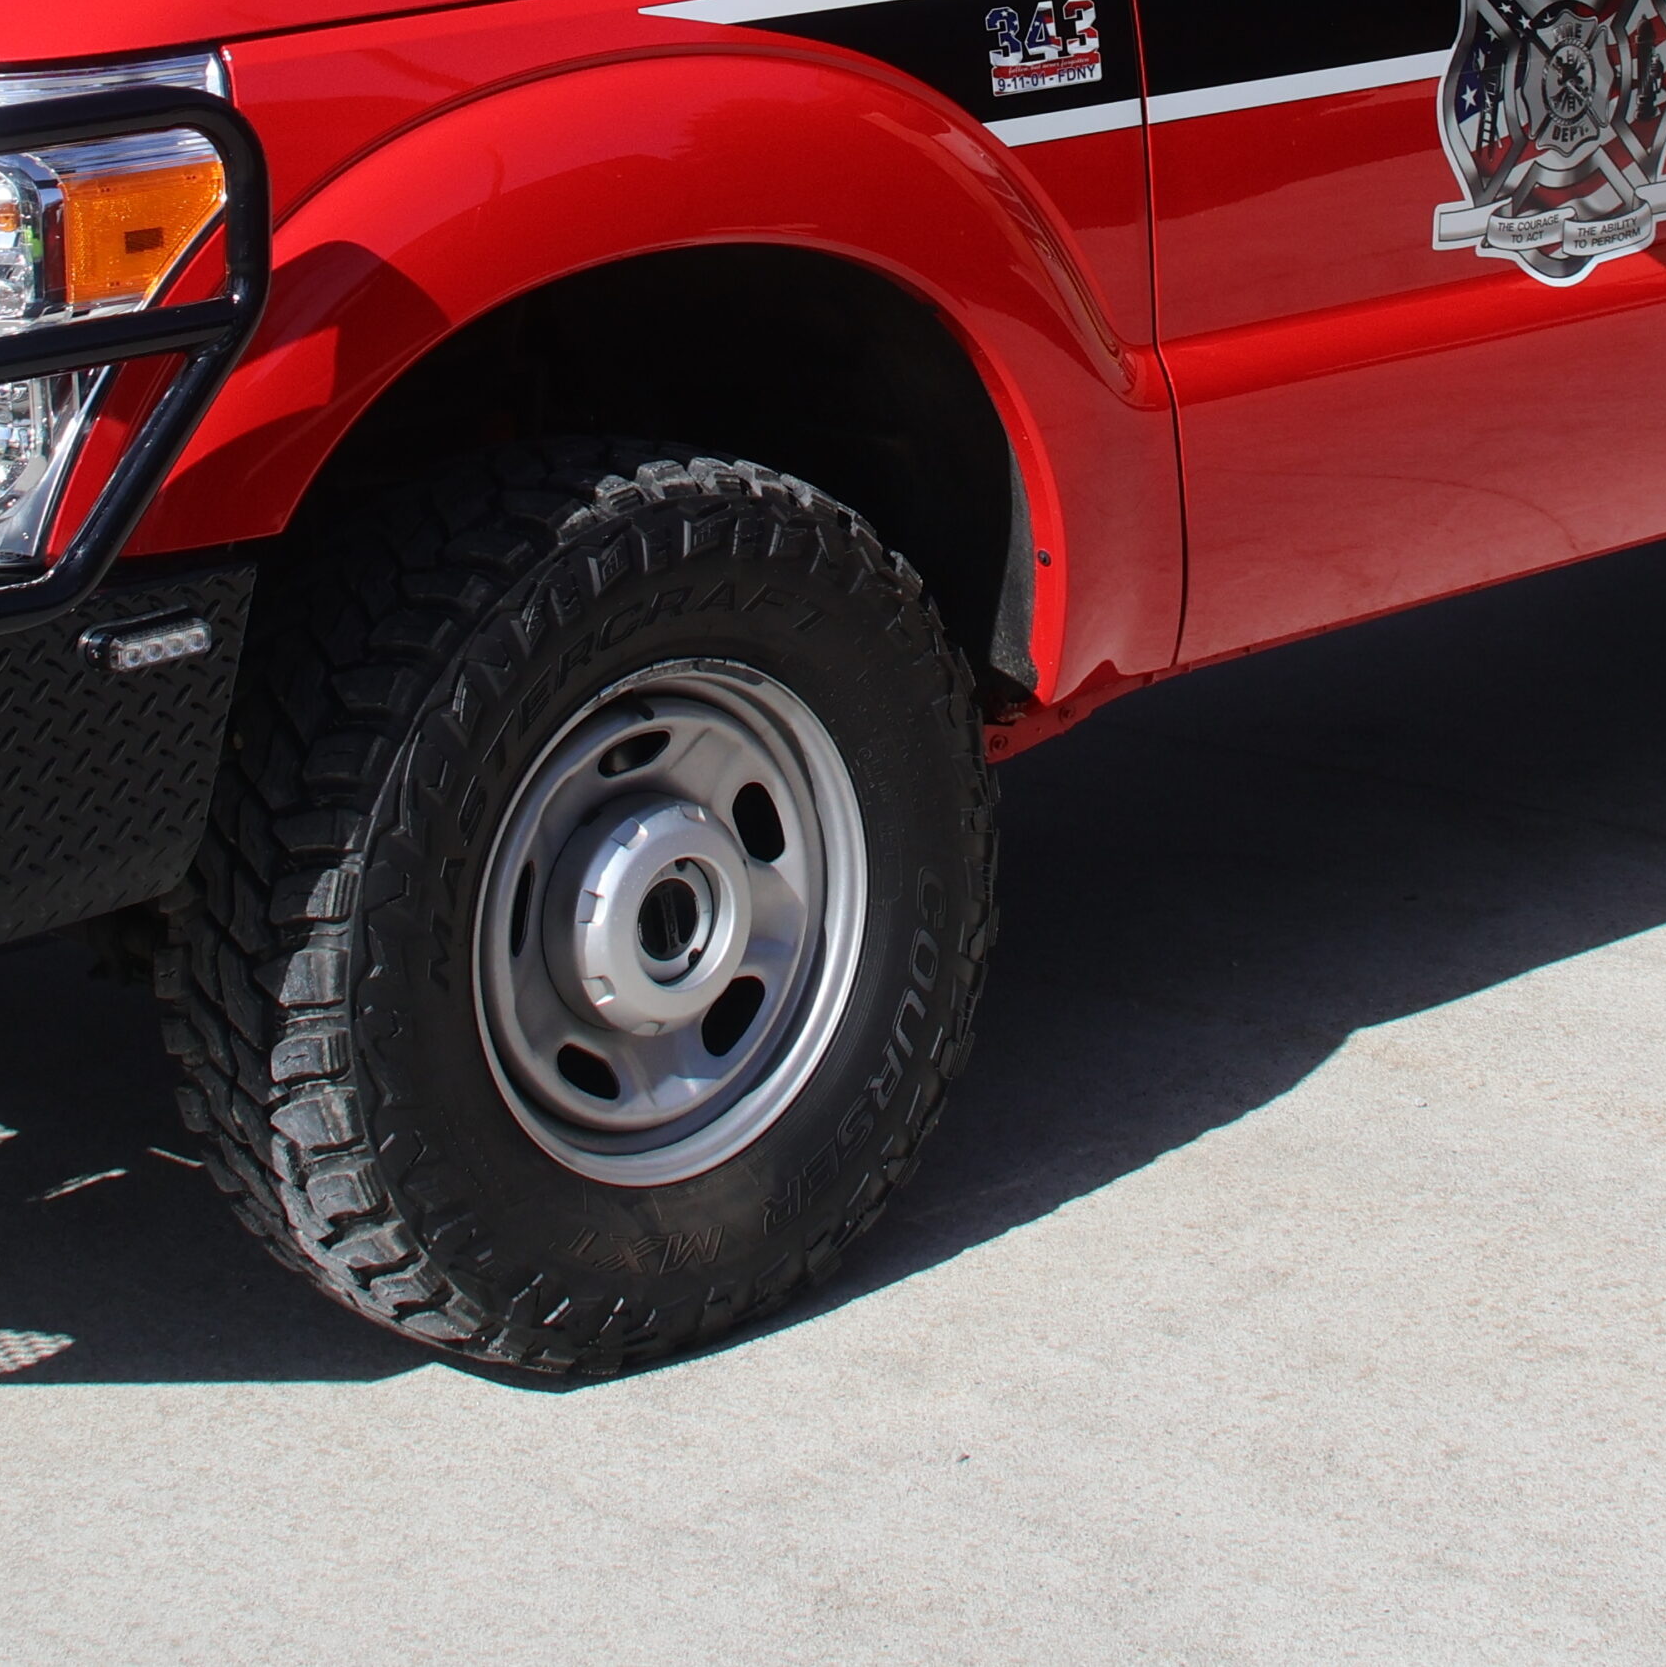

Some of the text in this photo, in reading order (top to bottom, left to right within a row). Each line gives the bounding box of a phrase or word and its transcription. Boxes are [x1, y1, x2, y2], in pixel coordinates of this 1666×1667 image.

[997, 71, 1046, 92] 9-11-01
[1057, 64, 1095, 83] FDNY
[1498, 214, 1560, 232] THE COURAGE
[1577, 216, 1638, 238] THE ABILITY
[1511, 231, 1544, 243] TO ACT
[1573, 227, 1641, 249] TO PERFORM
[763, 864, 951, 1236] COURSER
